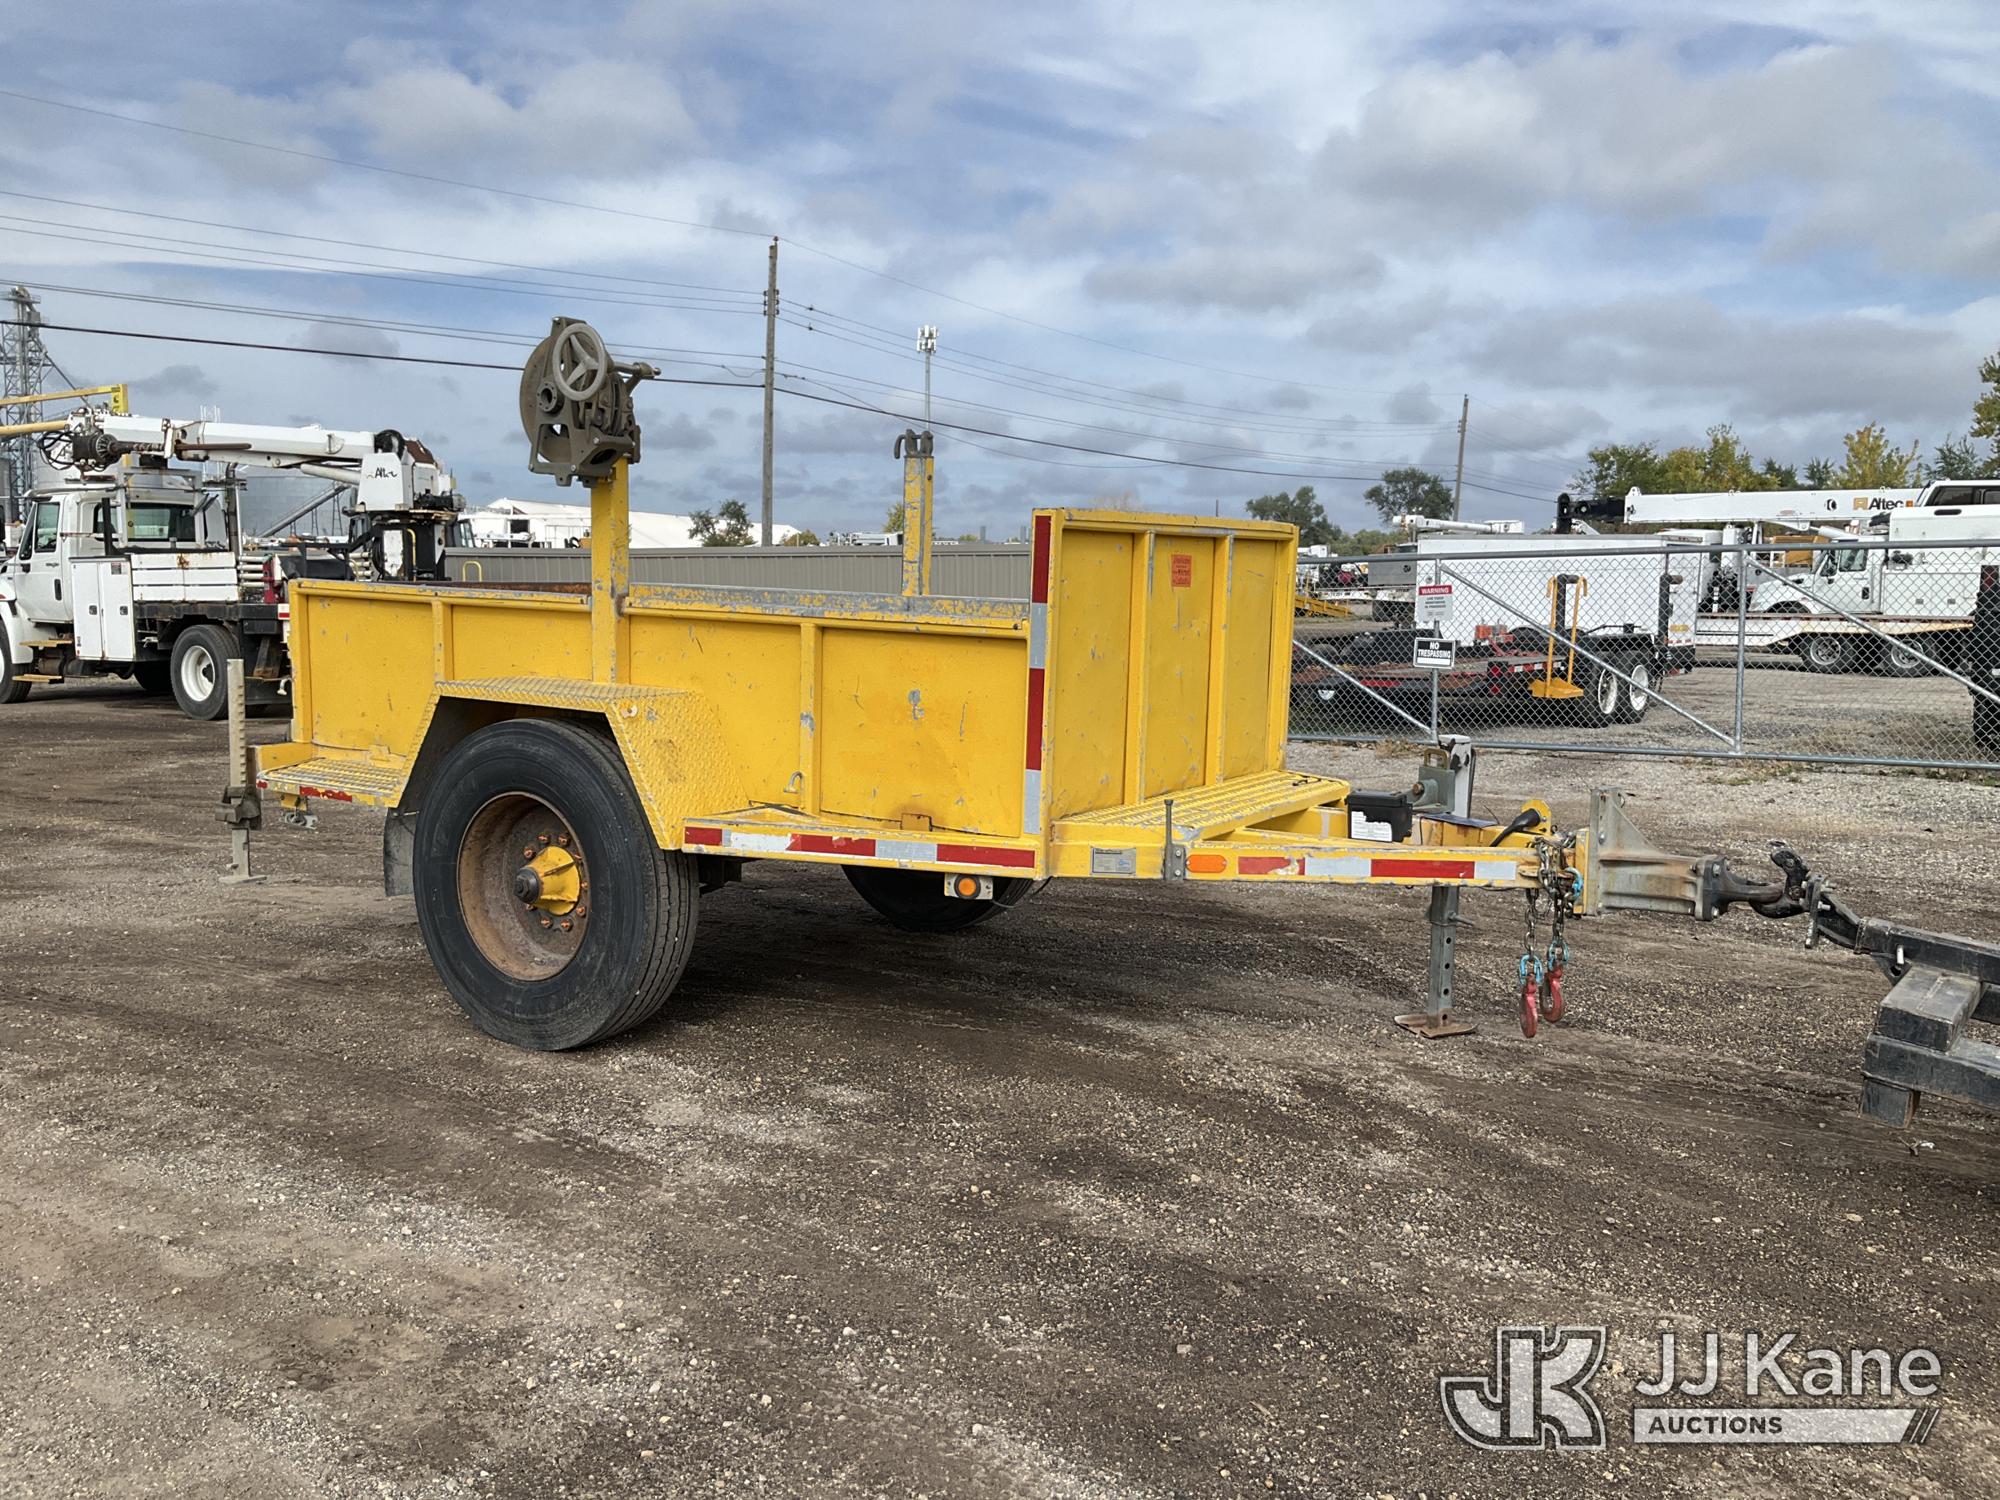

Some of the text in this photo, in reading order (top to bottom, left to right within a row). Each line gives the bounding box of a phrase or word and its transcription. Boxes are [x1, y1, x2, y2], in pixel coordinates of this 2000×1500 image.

[1868, 497, 1905, 511] Altec
[1421, 587, 1449, 595] WARNING
[1429, 641, 1440, 650] NO
[1417, 649, 1451, 658] TRESPASSING
